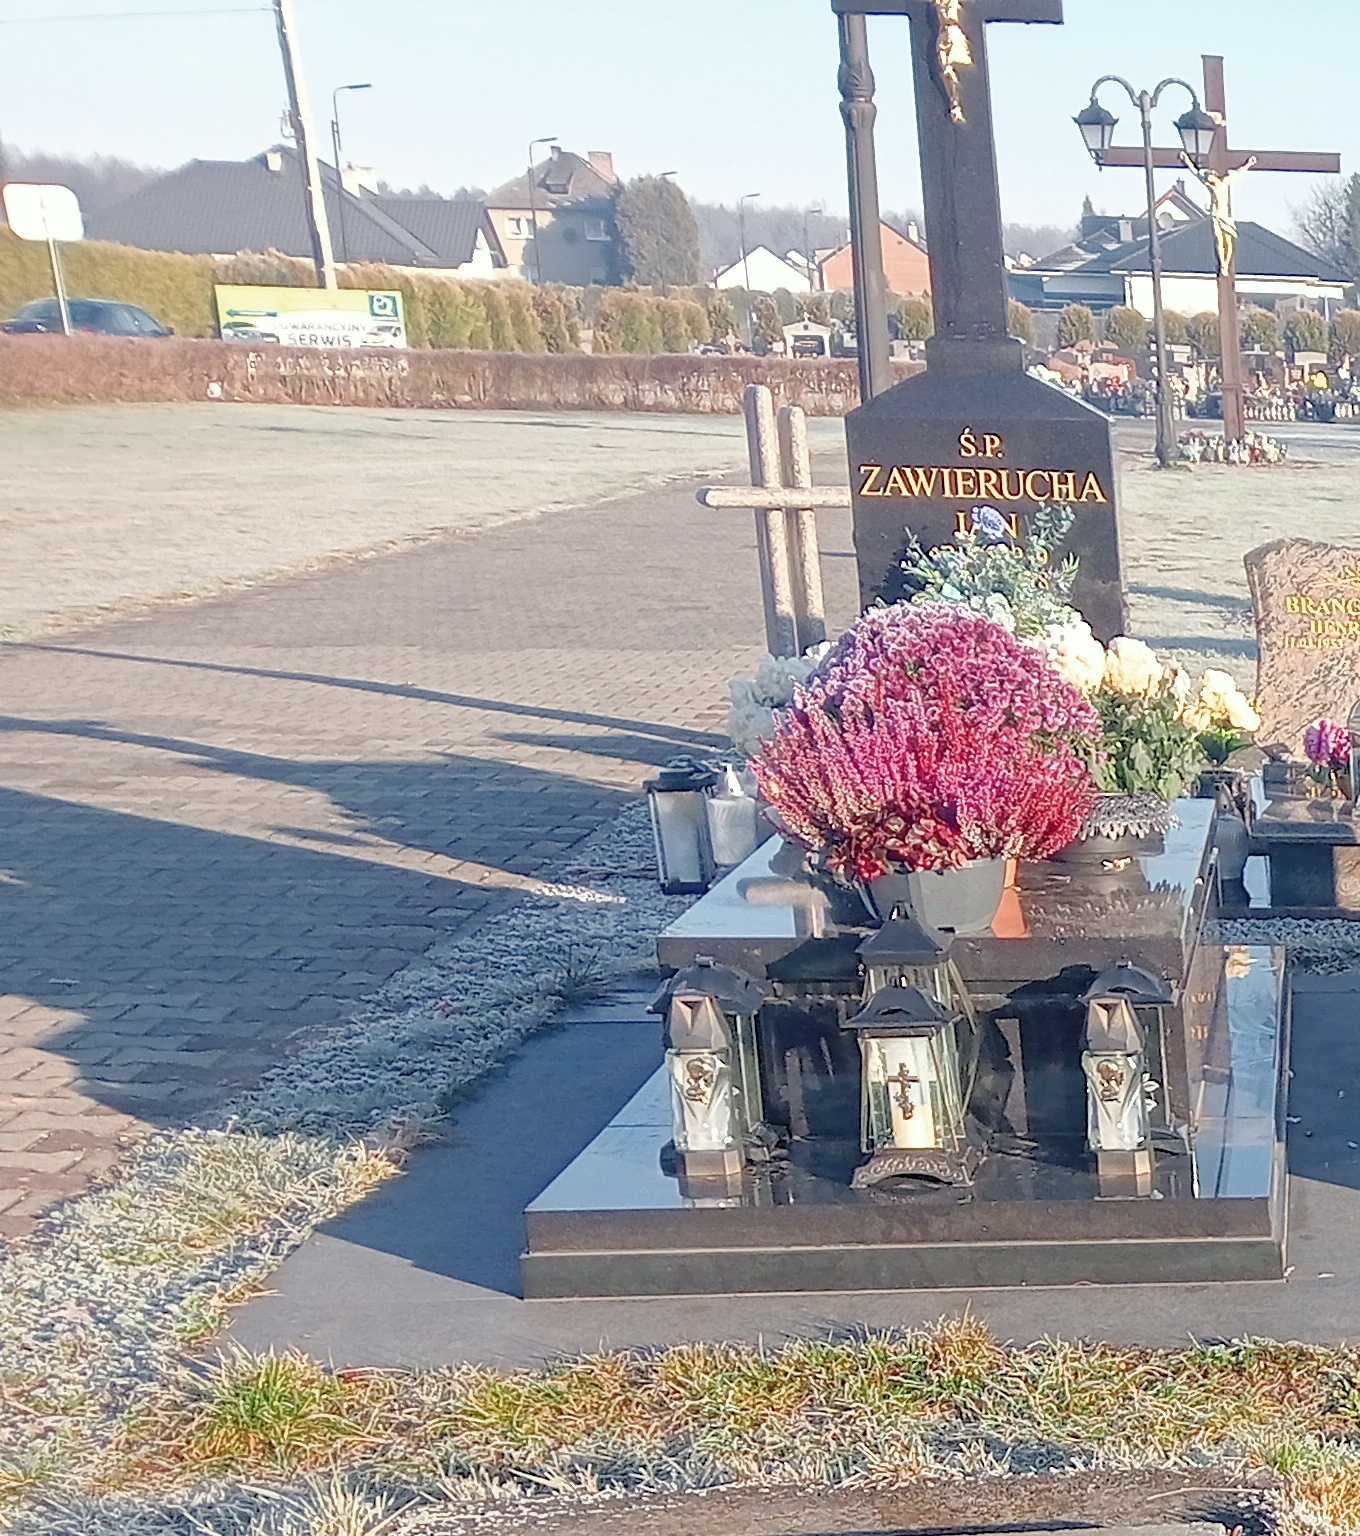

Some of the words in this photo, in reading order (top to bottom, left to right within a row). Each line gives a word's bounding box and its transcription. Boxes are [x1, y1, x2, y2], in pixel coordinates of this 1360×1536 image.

[287, 333, 352, 347] SERWIS
[959, 427, 1003, 458] Ś.P.
[859, 464, 1107, 503] ZAWIERUCHA
[955, 510, 1019, 540] JN
